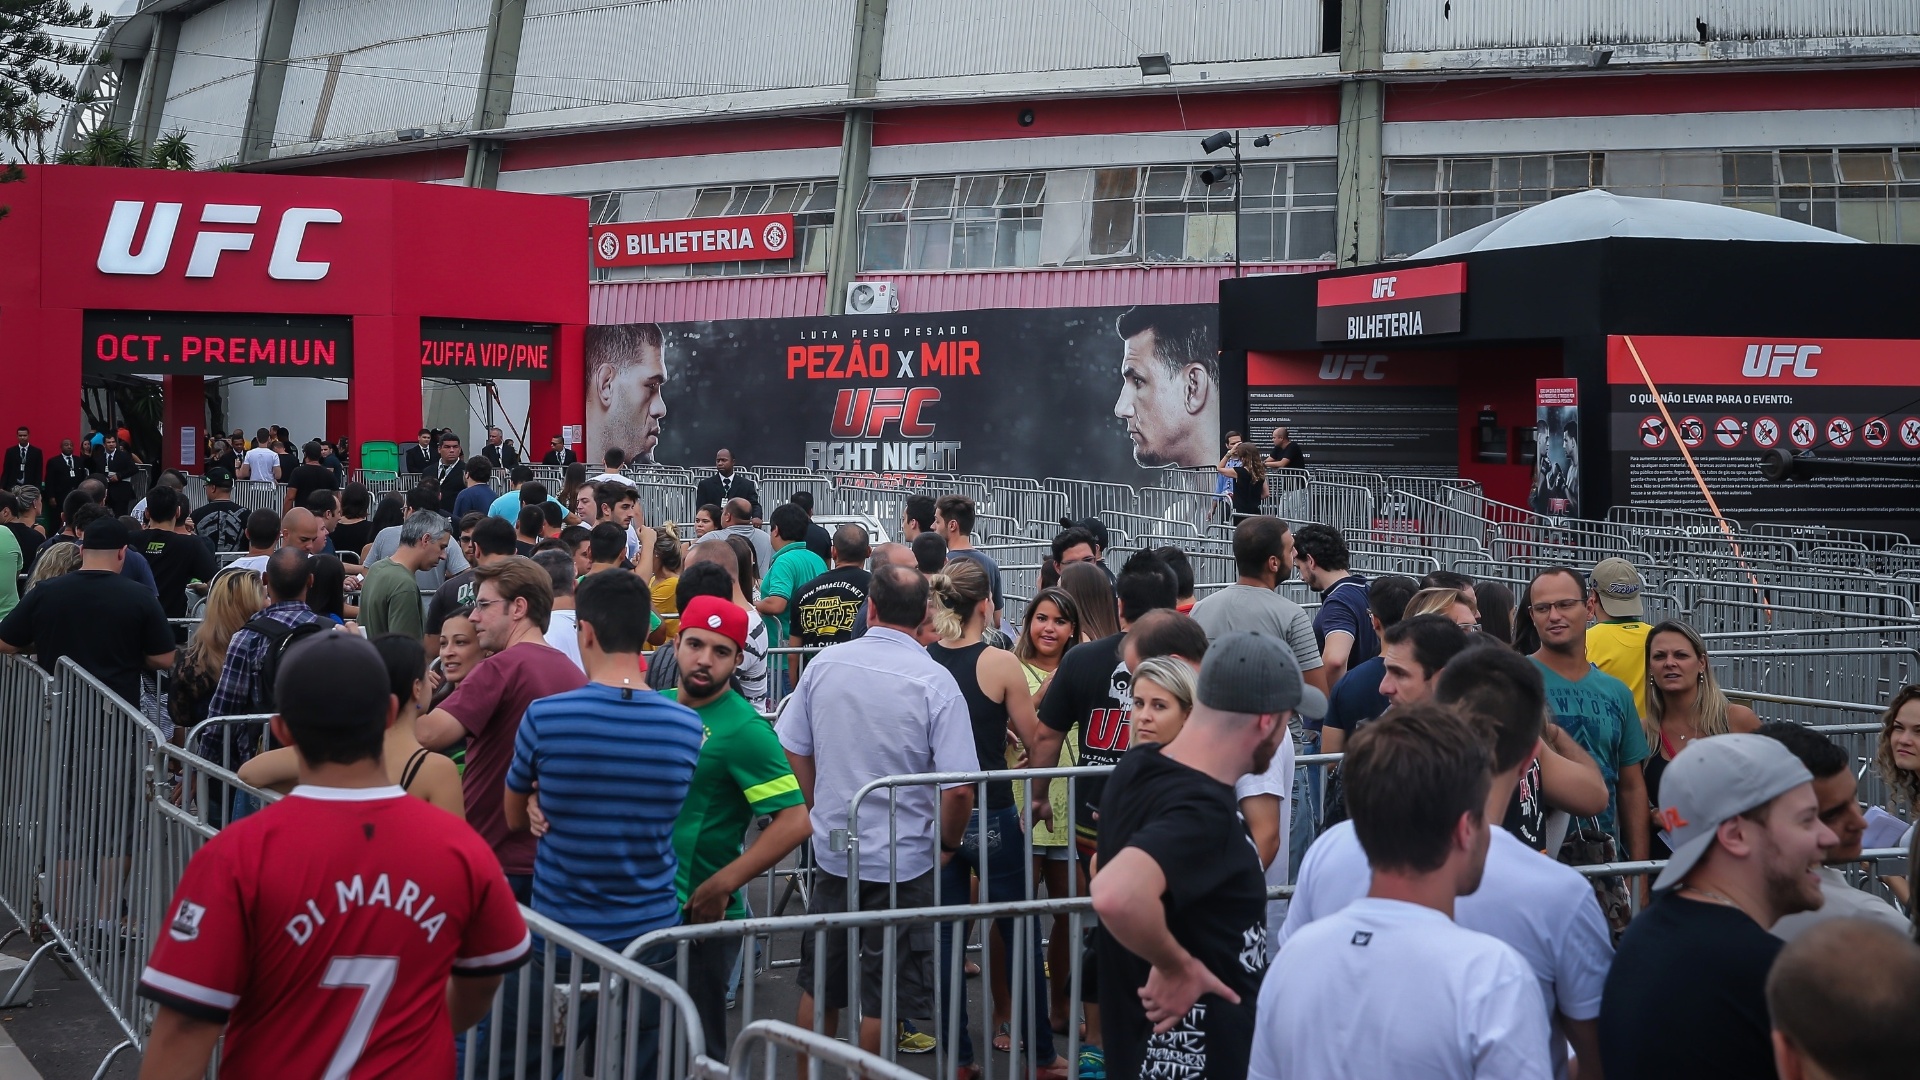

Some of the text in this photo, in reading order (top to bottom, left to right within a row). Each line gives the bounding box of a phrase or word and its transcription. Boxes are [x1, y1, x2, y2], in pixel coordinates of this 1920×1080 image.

[97, 200, 343, 281] UFC
[626, 227, 754, 255] BILHETERIA
[1372, 277, 1397, 299] UFC
[801, 325, 968, 340] LUTA PESO PESADO
[1347, 311, 1423, 340] BILHETERIA
[96, 334, 335, 365] OCT. PREMIUN
[421, 340, 548, 372] ZUFFA VIP/PNE
[787, 339, 889, 379] PEZÃO
[921, 340, 981, 377] MIR
[1741, 344, 1822, 378] UFC
[1319, 354, 1389, 380] UFC
[829, 386, 942, 439] UFC
[1629, 394, 1637, 403] O
[1660, 392, 1681, 404] NÃO
[1683, 394, 1714, 404] LEVAR
[1716, 394, 1742, 404] PARA
[1744, 395, 1751, 404] O
[1753, 395, 1793, 404] EVENTO:
[804, 441, 962, 471] FIGHT NIGHT
[803, 605, 856, 630] ELITE
[1085, 708, 1131, 752] UF
[1081, 753, 1121, 763] ULTIMAT
[285, 873, 447, 946] DI MARIA
[318, 955, 400, 1080] 7
